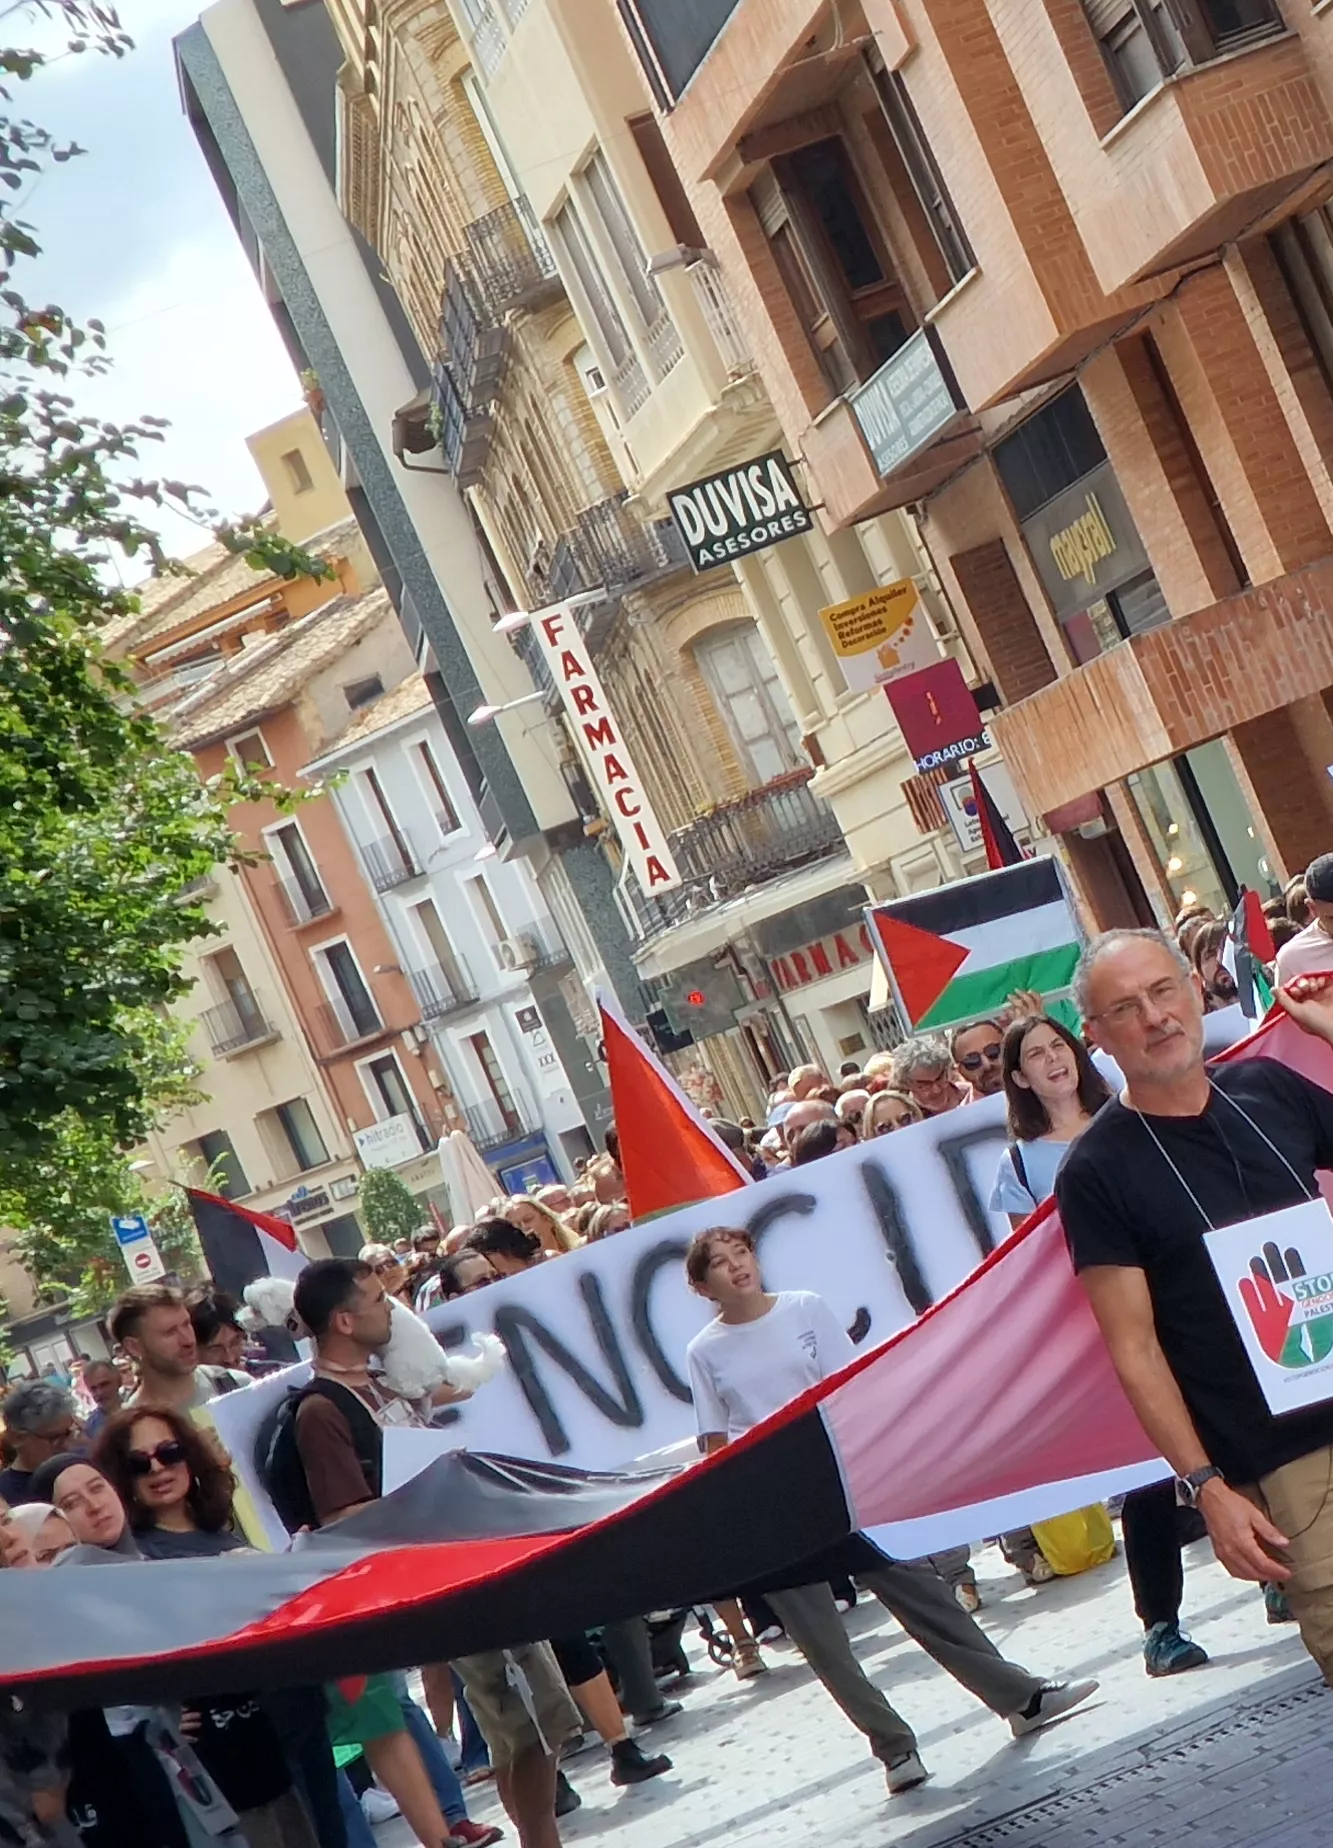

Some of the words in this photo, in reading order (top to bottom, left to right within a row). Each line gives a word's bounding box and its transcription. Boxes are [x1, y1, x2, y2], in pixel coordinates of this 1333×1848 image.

[671, 458, 799, 547] DUVISA
[699, 510, 807, 566] ASESORES
[829, 602, 866, 622] Compra
[868, 586, 908, 607] Alquiler
[833, 606, 888, 632] Inversiones
[837, 619, 884, 640] Reformas
[540, 613, 672, 888] FARMACIA
[771, 923, 874, 991] FARMA
